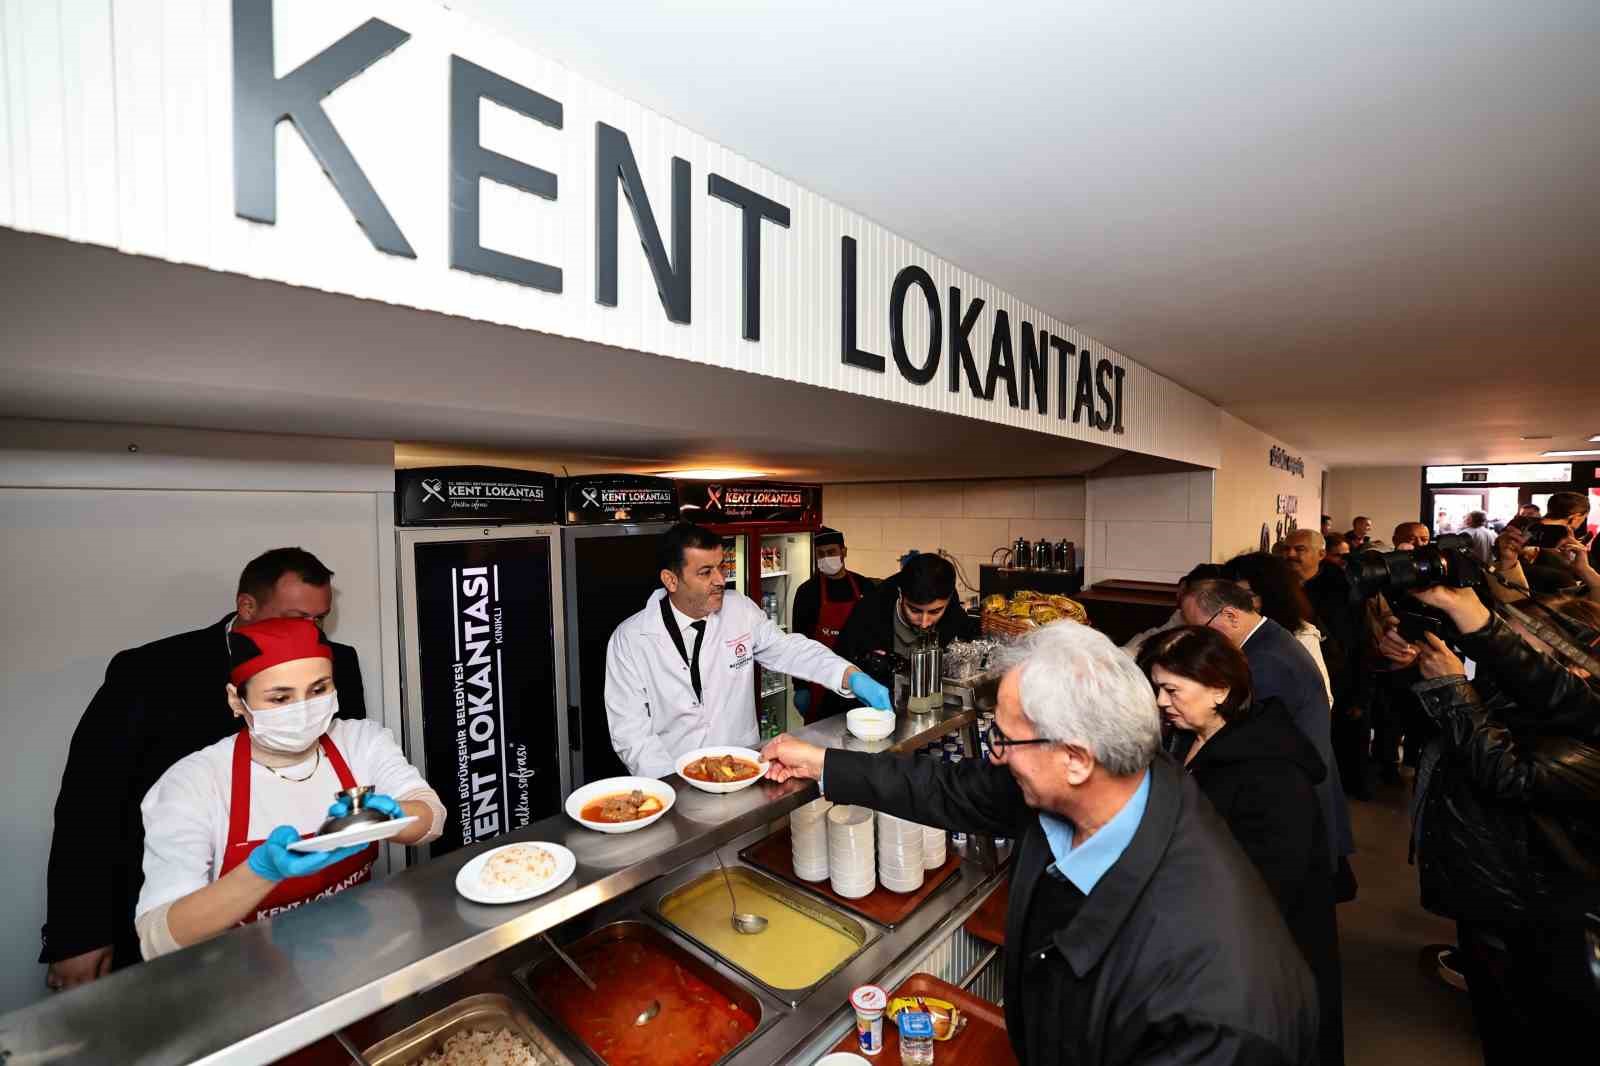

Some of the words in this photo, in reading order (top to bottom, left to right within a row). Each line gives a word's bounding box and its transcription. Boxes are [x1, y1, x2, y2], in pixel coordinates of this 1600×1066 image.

[231, 0, 790, 342] KENT
[841, 235, 1126, 434] LOKANTASI
[448, 486, 482, 496] KENT
[485, 486, 544, 498] LOKANTASI
[602, 493, 626, 502] KENT
[629, 492, 671, 501] LOKANTASI
[725, 492, 751, 503] KENT
[753, 492, 801, 504] LOKANTASI
[462, 566, 495, 761] LOKANTASI
[452, 662, 466, 726] BELEDİYESİ
[455, 728, 470, 799] BÜYÜKŞEHİR
[458, 801, 473, 846] DENİZLİ
[471, 772, 500, 842] ENT
[514, 790, 530, 830] alkın
